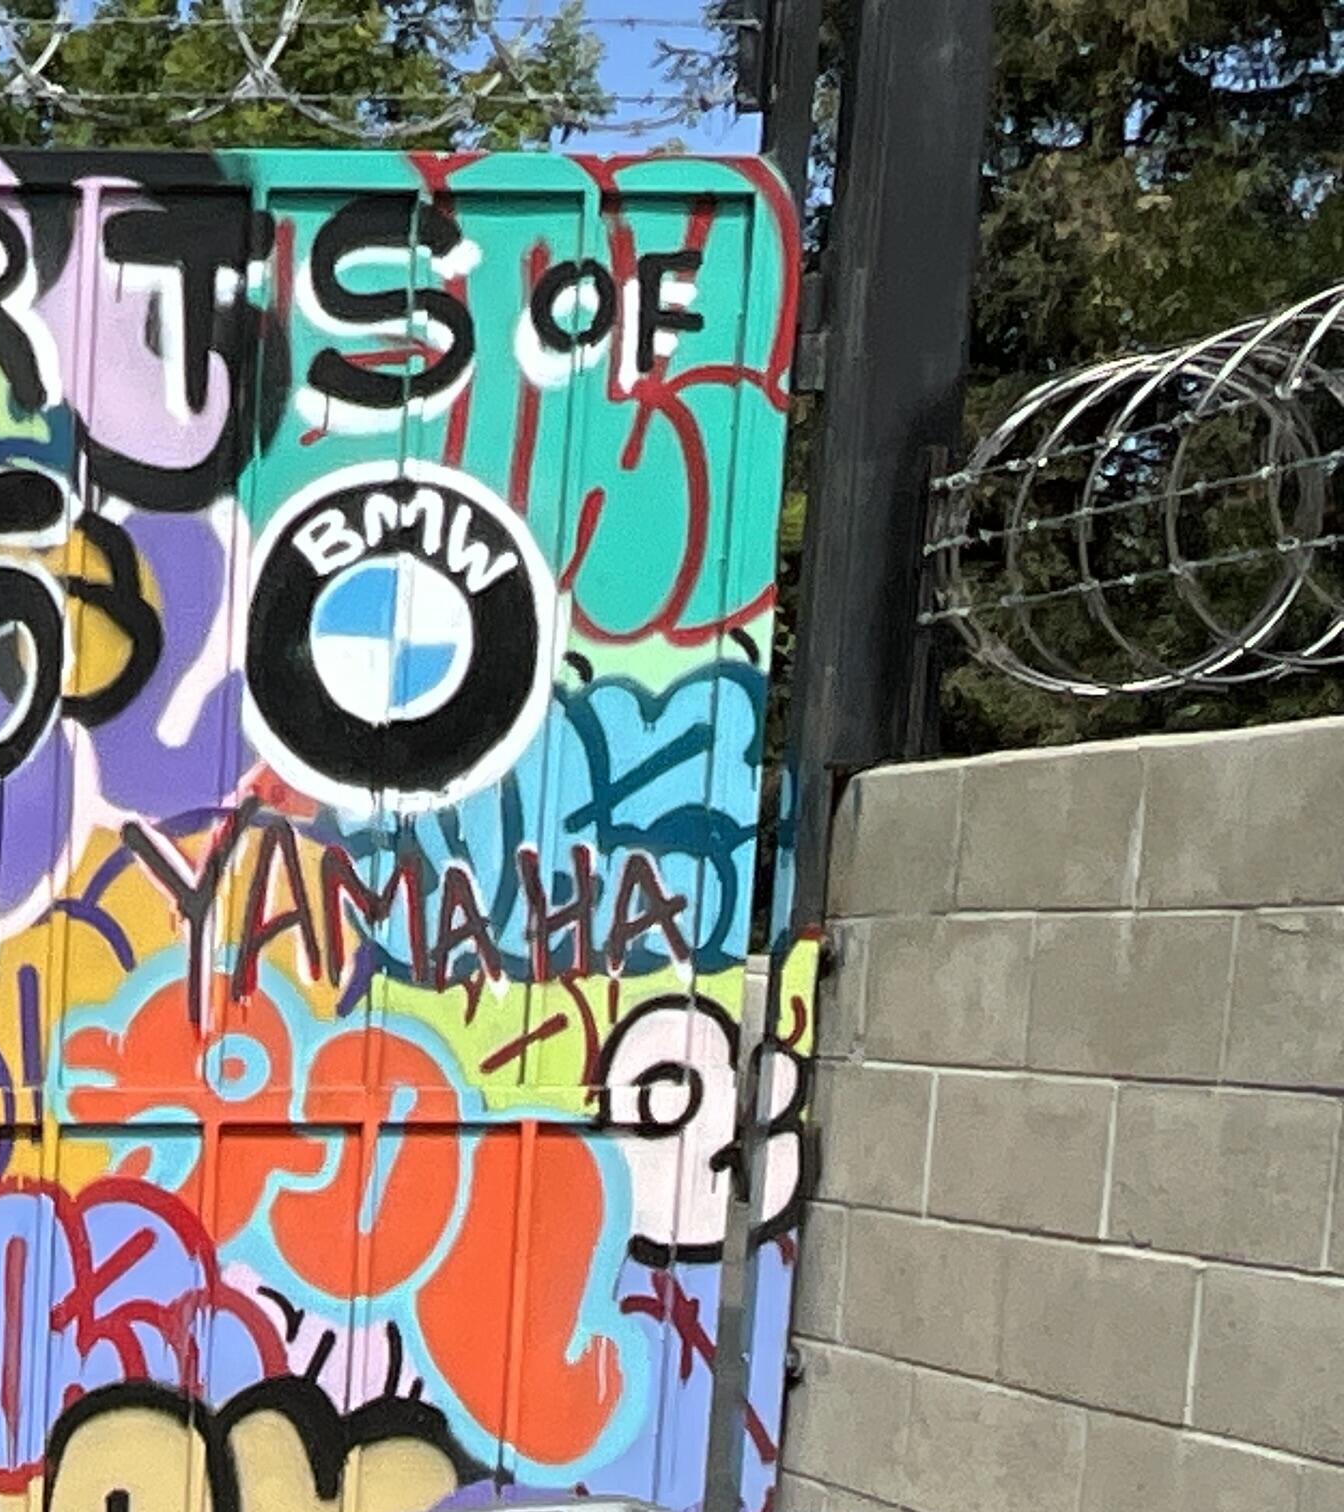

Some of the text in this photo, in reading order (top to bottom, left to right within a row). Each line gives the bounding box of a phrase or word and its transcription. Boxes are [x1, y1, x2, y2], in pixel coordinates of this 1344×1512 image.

[520, 248, 707, 388] OF
[291, 487, 518, 594] BMW
[120, 797, 697, 1040] YAMAHA
